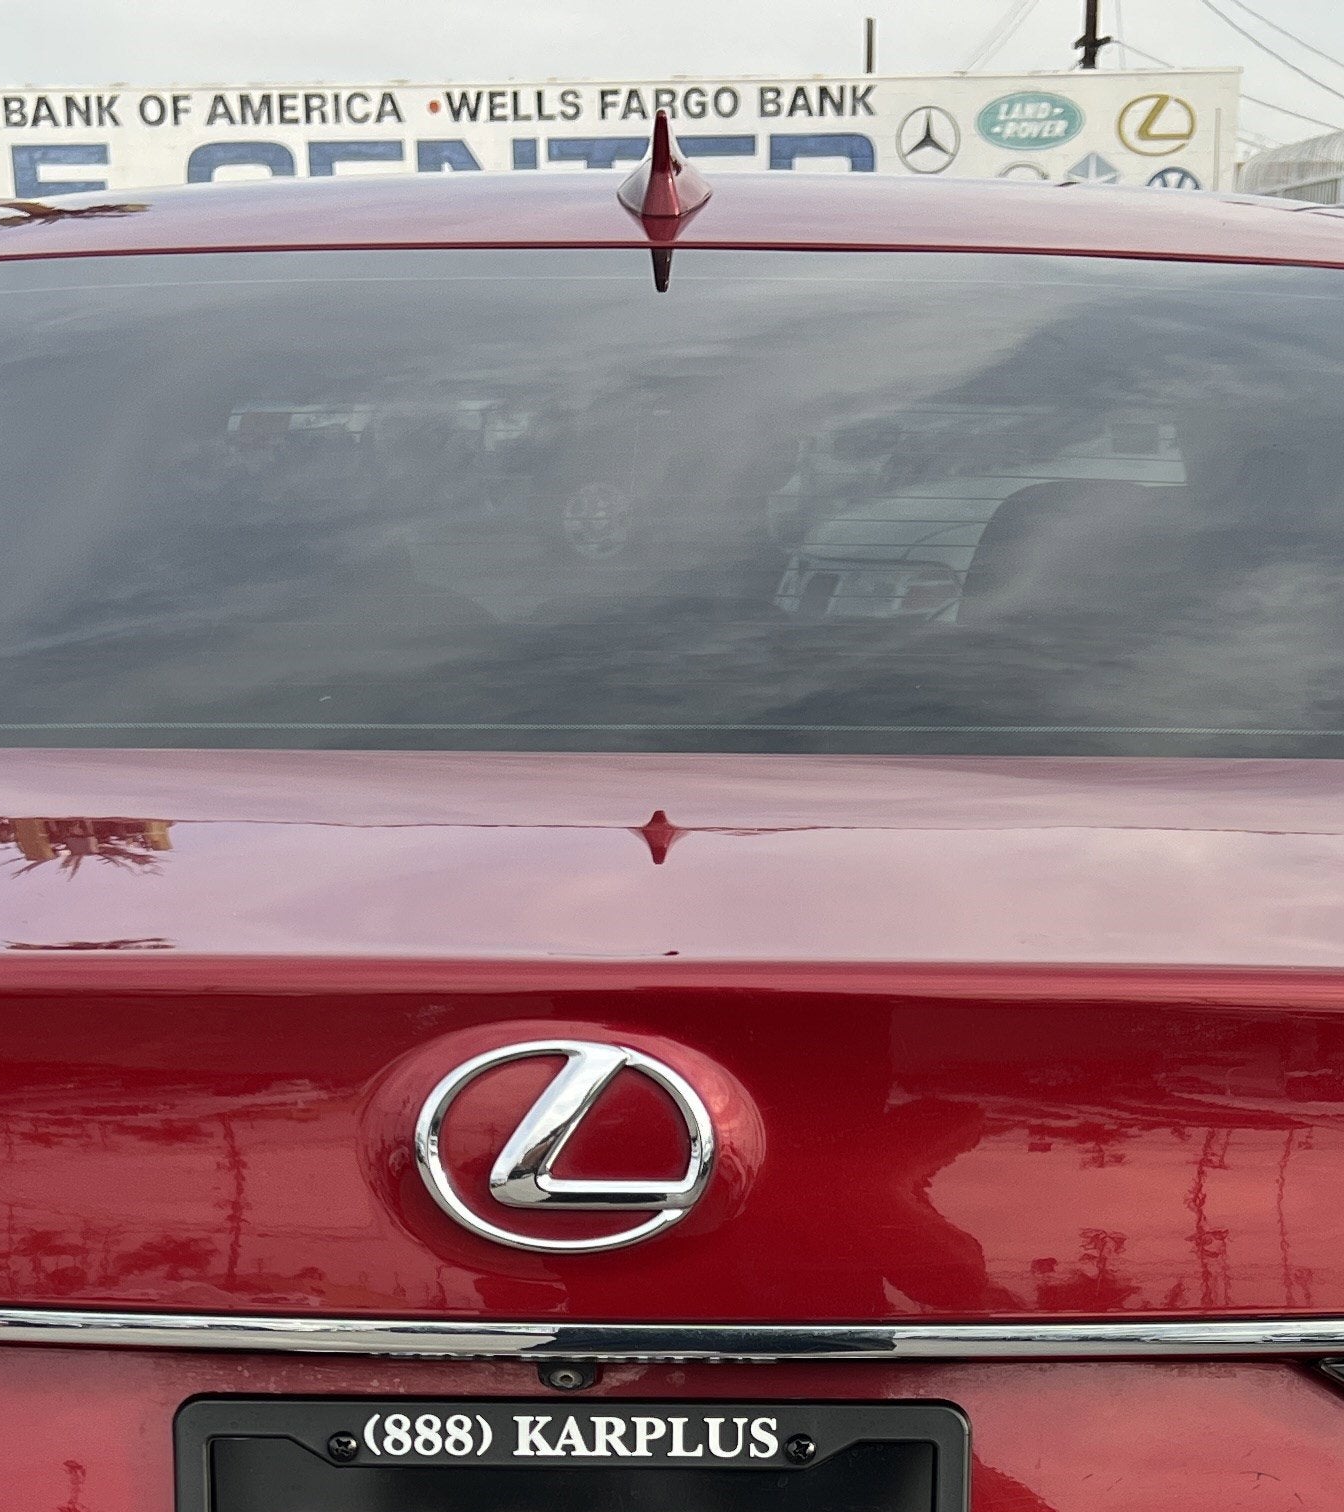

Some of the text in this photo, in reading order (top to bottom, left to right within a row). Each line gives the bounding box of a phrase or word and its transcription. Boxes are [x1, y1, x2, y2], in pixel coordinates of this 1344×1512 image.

[3, 95, 120, 128] BANK
[139, 94, 191, 127] OF
[207, 91, 404, 126] AMERICA
[445, 90, 581, 123] WELLS
[599, 86, 739, 124] FARGO
[760, 85, 876, 118] BANK
[362, 1413, 780, 1460] (888) KARPLUS
